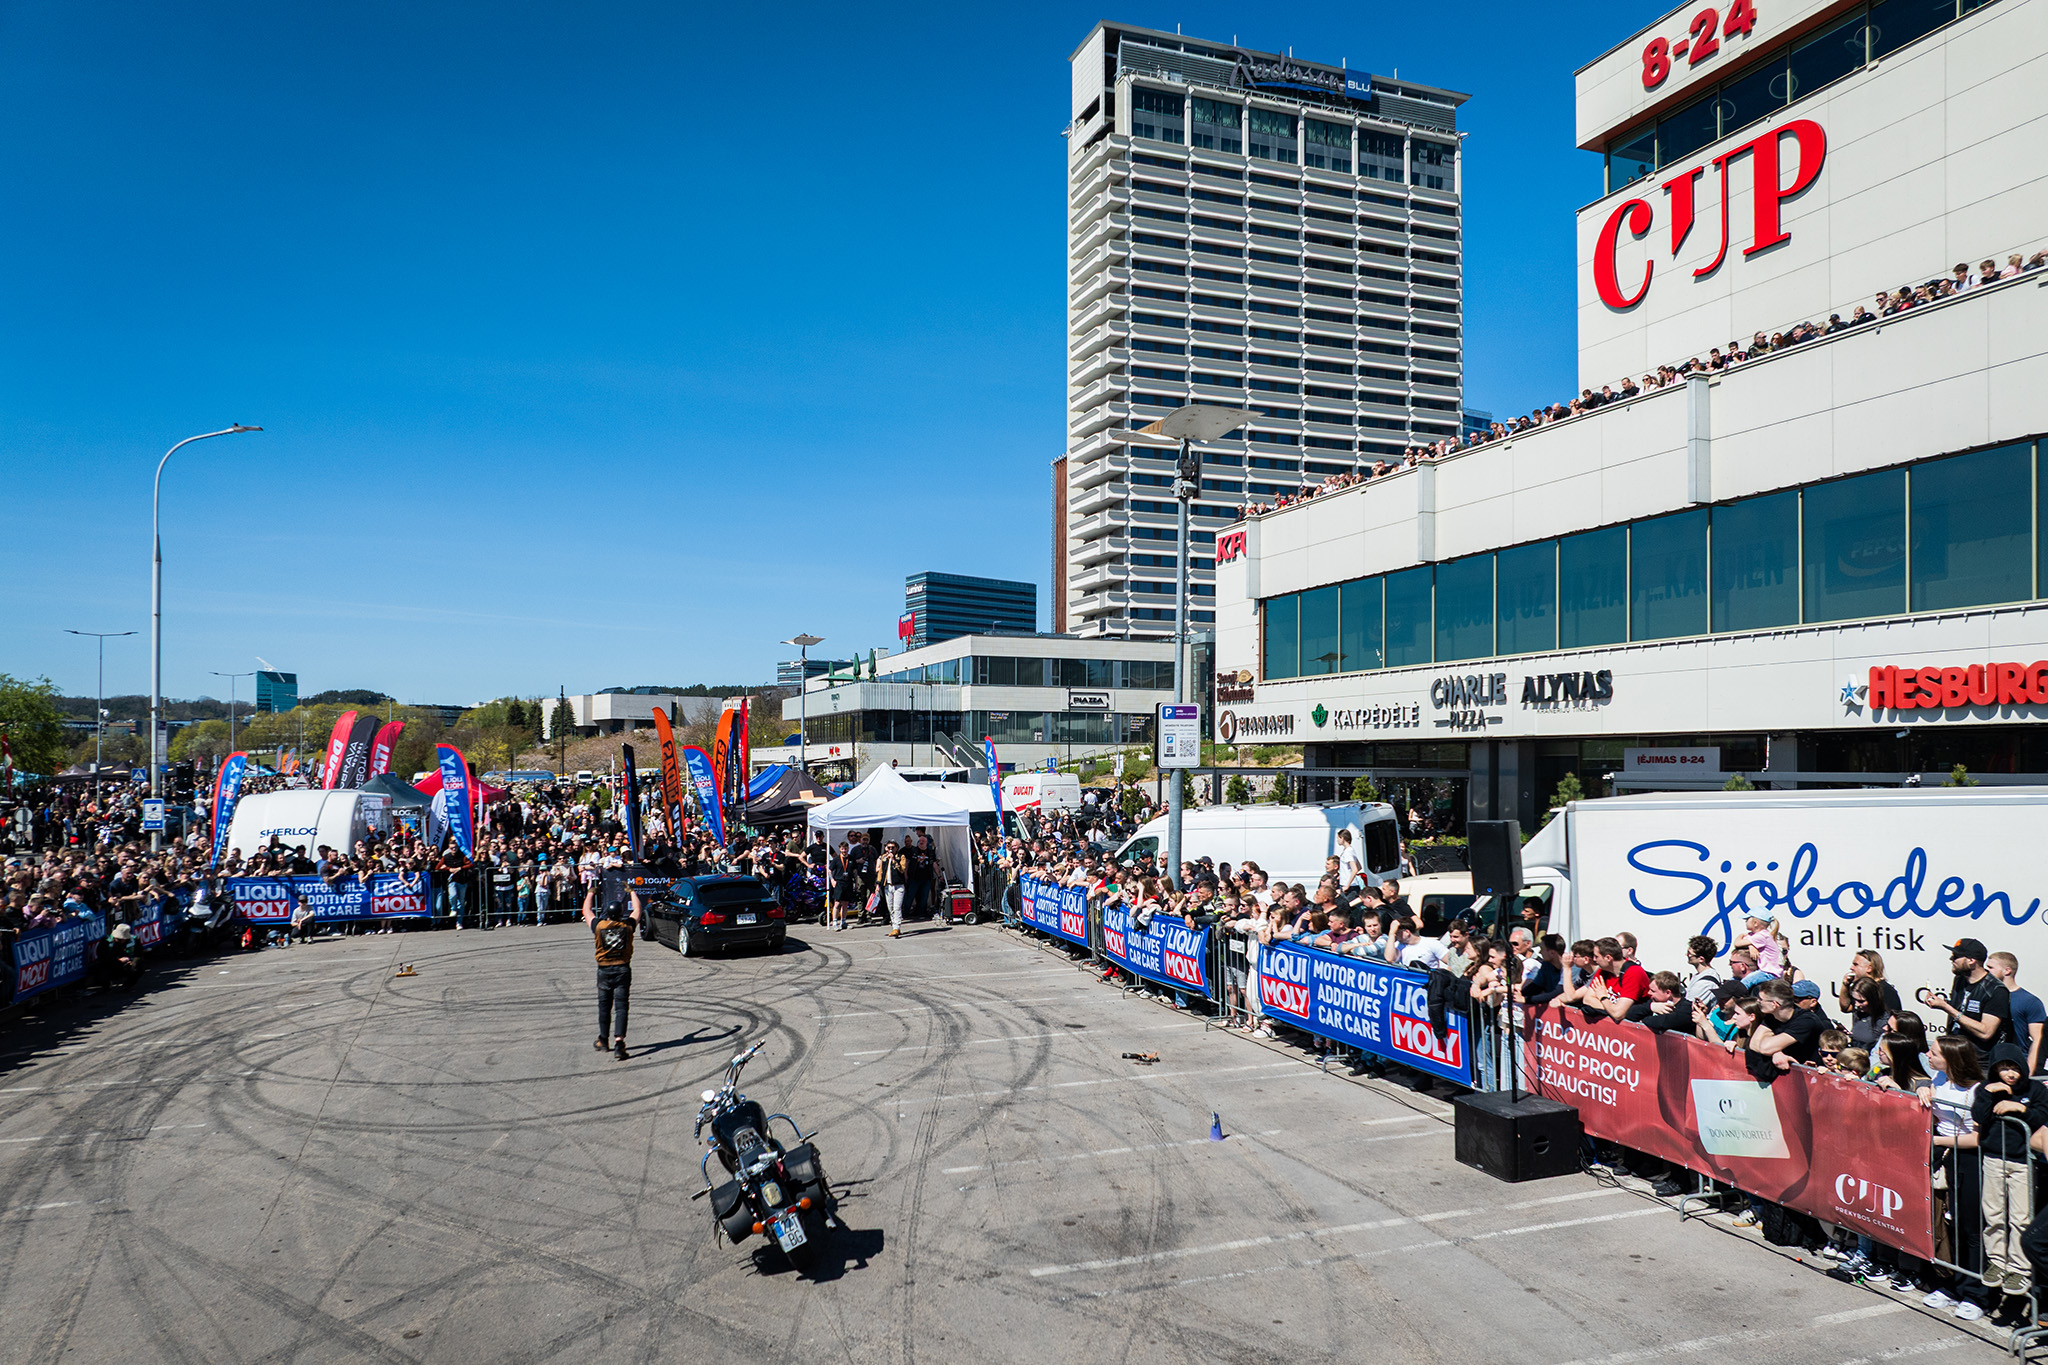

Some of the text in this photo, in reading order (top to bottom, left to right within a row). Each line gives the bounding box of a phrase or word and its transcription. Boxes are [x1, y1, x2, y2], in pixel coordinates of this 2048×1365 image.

[1642, 0, 1757, 87] 8-24
[1228, 46, 1370, 92] Radisson BLU
[1593, 119, 1827, 308] CUP
[906, 584, 923, 595] Luminor
[1430, 672, 1507, 710] CHARLIE
[1521, 669, 1614, 704] ALYNAS
[1869, 660, 2048, 710] HESBURG
[1073, 696, 1105, 705] PIAZZA
[1165, 708, 1173, 717] P
[1240, 714, 1295, 732] MANAMI
[1334, 702, 1420, 727] KATPĖDĖLĖ
[1450, 710, 1486, 730] PIZZA
[1637, 754, 1705, 766] ĮĖJIMAS 8-24
[1013, 786, 1034, 796] DUCATI
[260, 828, 318, 839] SHERLOG
[234, 884, 288, 901] LIQUI
[294, 882, 367, 894] MOTOR OILS
[307, 894, 363, 905] DDITIVES
[1627, 839, 2041, 957] Sjöboden
[236, 901, 289, 917] MOLY
[312, 905, 361, 916] AR CARE
[374, 896, 426, 912] MOLY
[1036, 899, 1059, 914] ADDITIVES
[1062, 891, 1084, 914] LIQUI
[1037, 912, 1058, 930] CAR CARE
[1061, 911, 1085, 937] MOLY
[1104, 907, 1124, 932] LIQUI
[17, 937, 49, 966] LIQUI
[1104, 929, 1125, 957] MOLY
[1167, 927, 1201, 957] LIQUI
[1800, 925, 1926, 952] allt i fisk
[53, 960, 83, 978] CAR CARE
[1129, 950, 1161, 973] CAR CARE
[1165, 953, 1202, 985] MOLY
[1262, 949, 1308, 985] LIQUI
[20, 960, 49, 990] MOLY
[1314, 959, 1388, 997] MOTOR OILS
[1263, 978, 1309, 1014] MOLY
[1317, 983, 1381, 1019] ADDITIVES
[1318, 1005, 1381, 1043] CAR CARE
[1394, 1016, 1459, 1062] MOLY
[1534, 1018, 1636, 1062] PADOVANOK
[1535, 1042, 1640, 1091] DAUG PROGŲ
[1535, 1060, 1617, 1107] DŽIAUGTIS!
[1709, 1128, 1773, 1141] DOVANŲ KORTELĖ
[1835, 1173, 1903, 1220] CUP
[1835, 1206, 1905, 1235] PREKYBOS CENTRAS
[788, 1229, 804, 1247] BG
